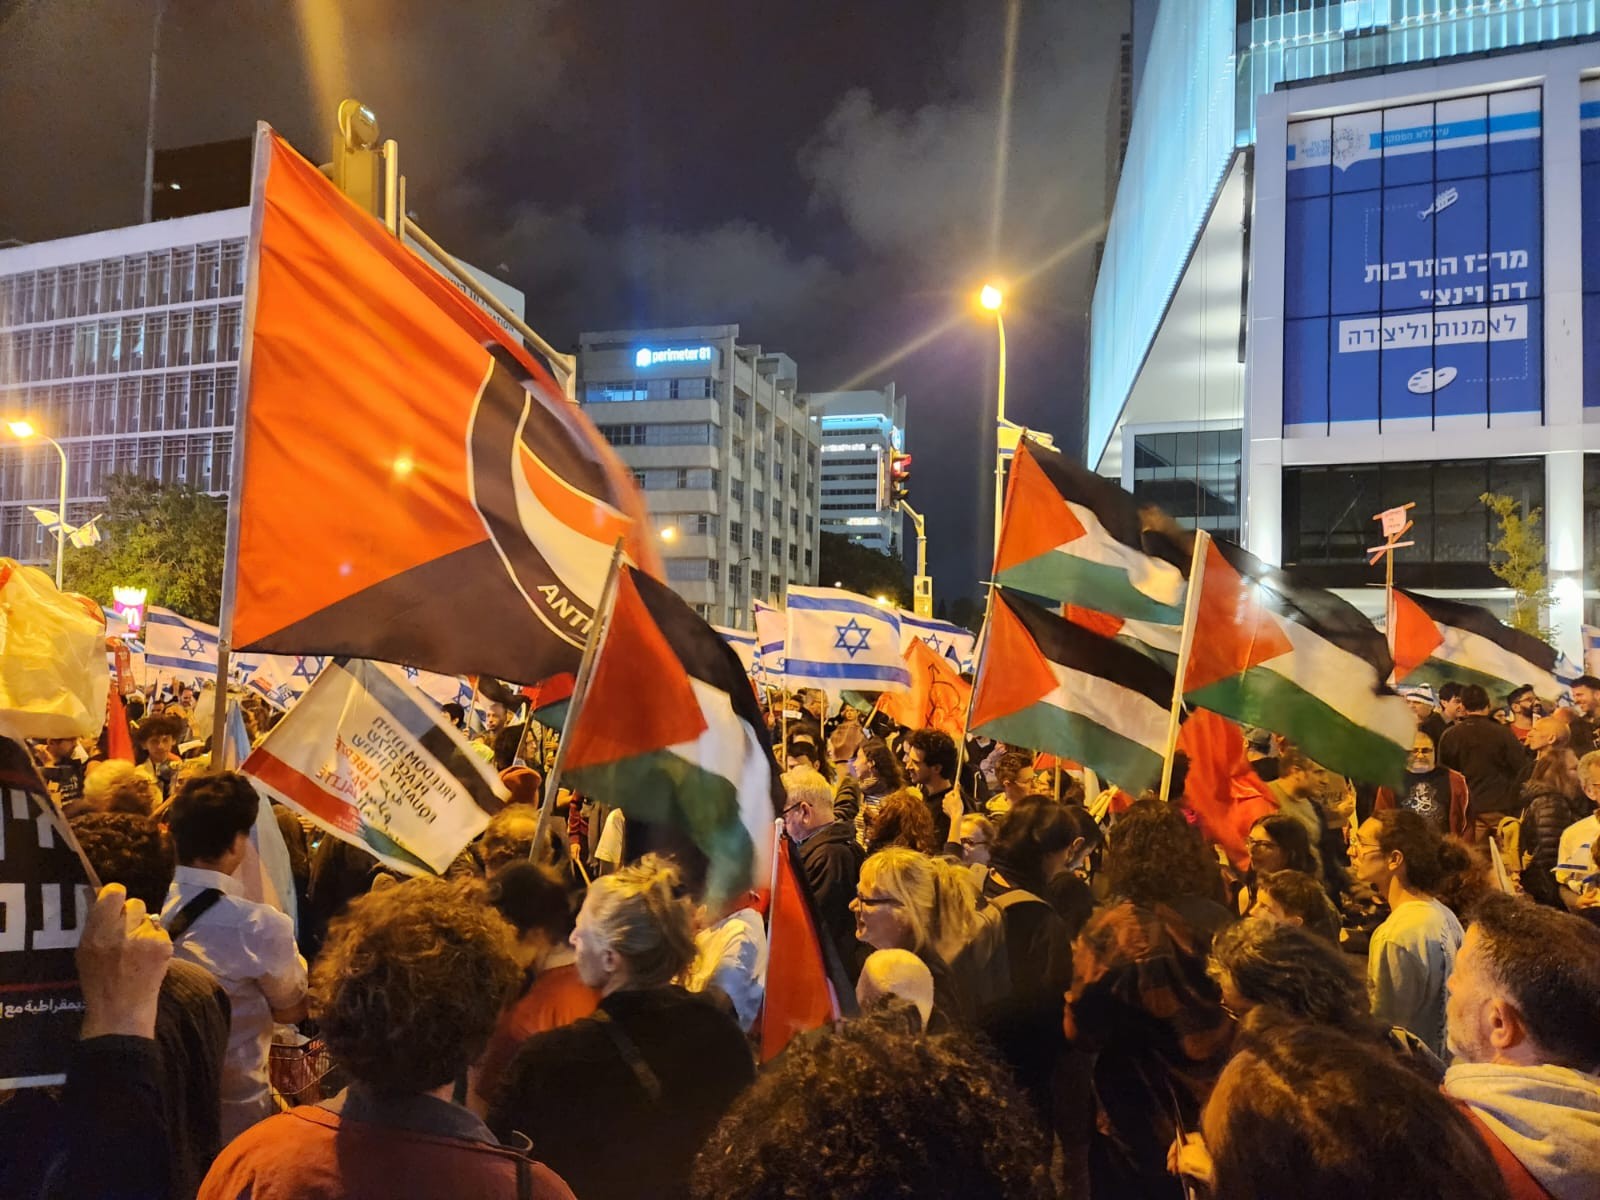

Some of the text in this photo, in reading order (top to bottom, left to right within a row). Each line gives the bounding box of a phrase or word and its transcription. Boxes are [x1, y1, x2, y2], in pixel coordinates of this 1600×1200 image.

[1364, 249, 1528, 283] מרכז התרבות
[1493, 281, 1528, 301] דה
[1348, 314, 1517, 346] לאמנות וליצירה
[652, 348, 699, 364] perimeter
[4, 1004, 24, 1018] مع
